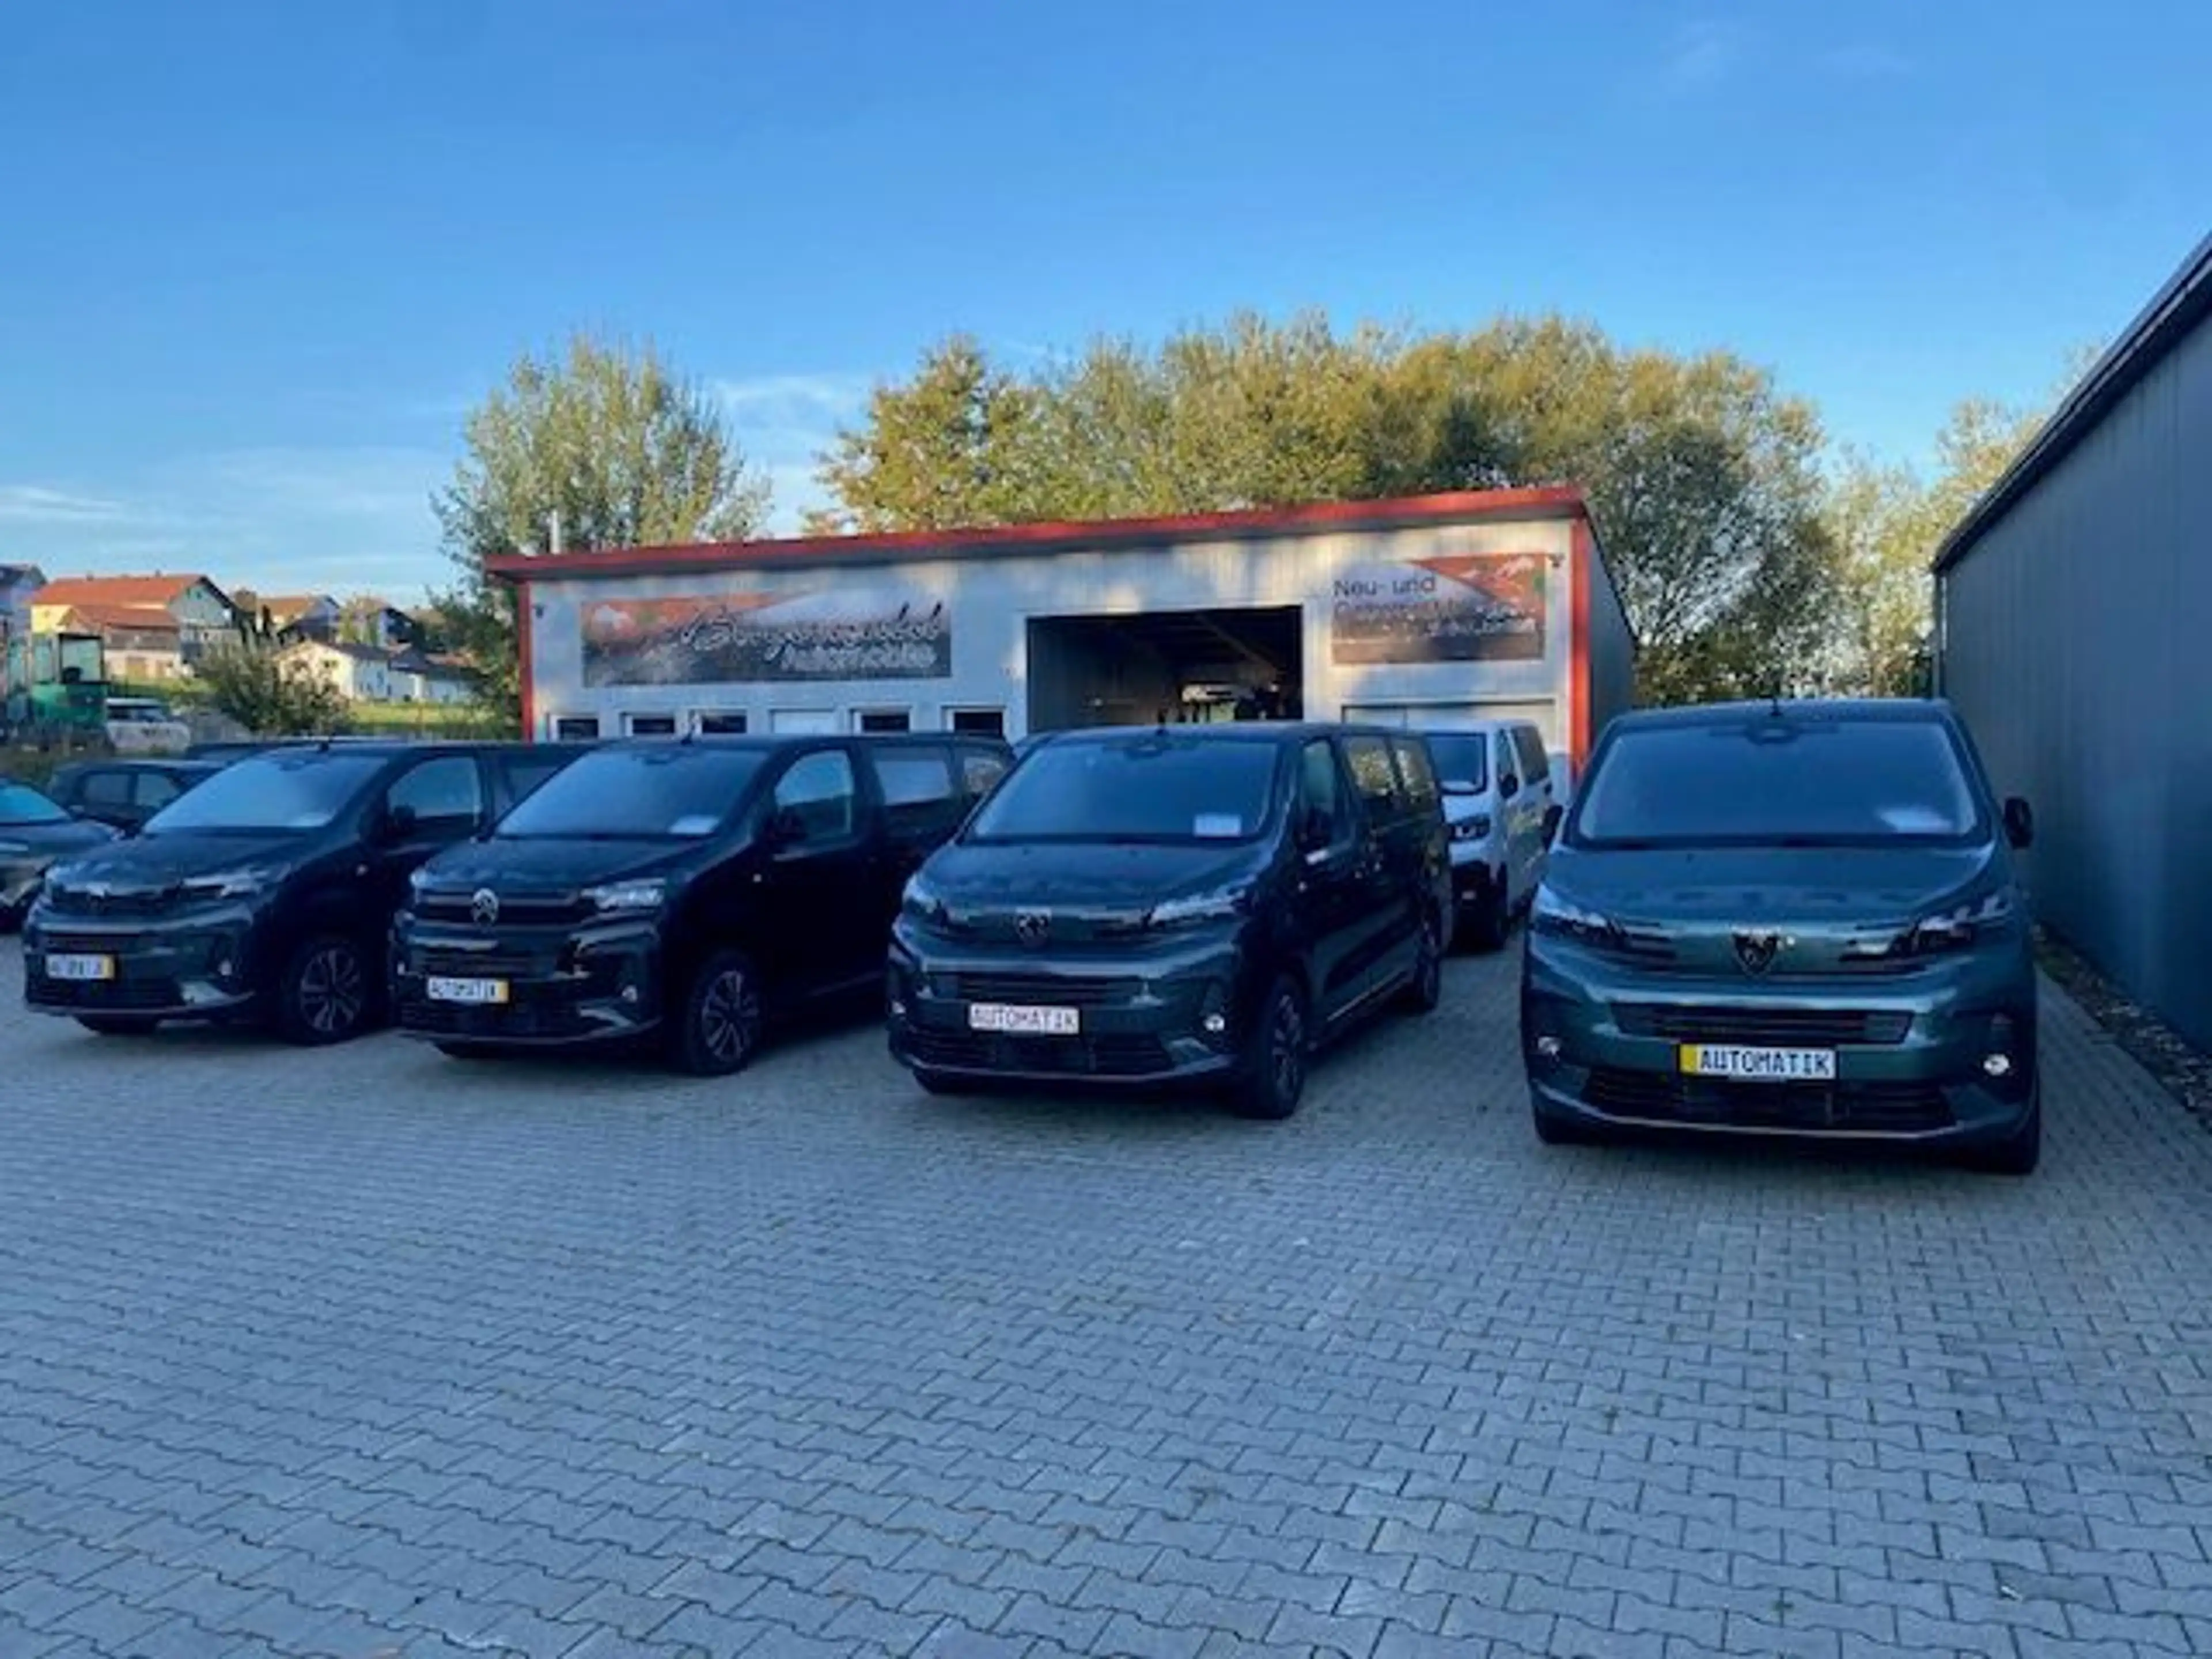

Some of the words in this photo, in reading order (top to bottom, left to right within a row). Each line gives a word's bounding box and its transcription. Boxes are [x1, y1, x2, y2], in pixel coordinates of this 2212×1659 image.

[1392, 575, 1435, 594] und
[973, 1007, 1076, 1030] AUTOMATIK
[1701, 1050, 1830, 1075] AUTOMATIK
